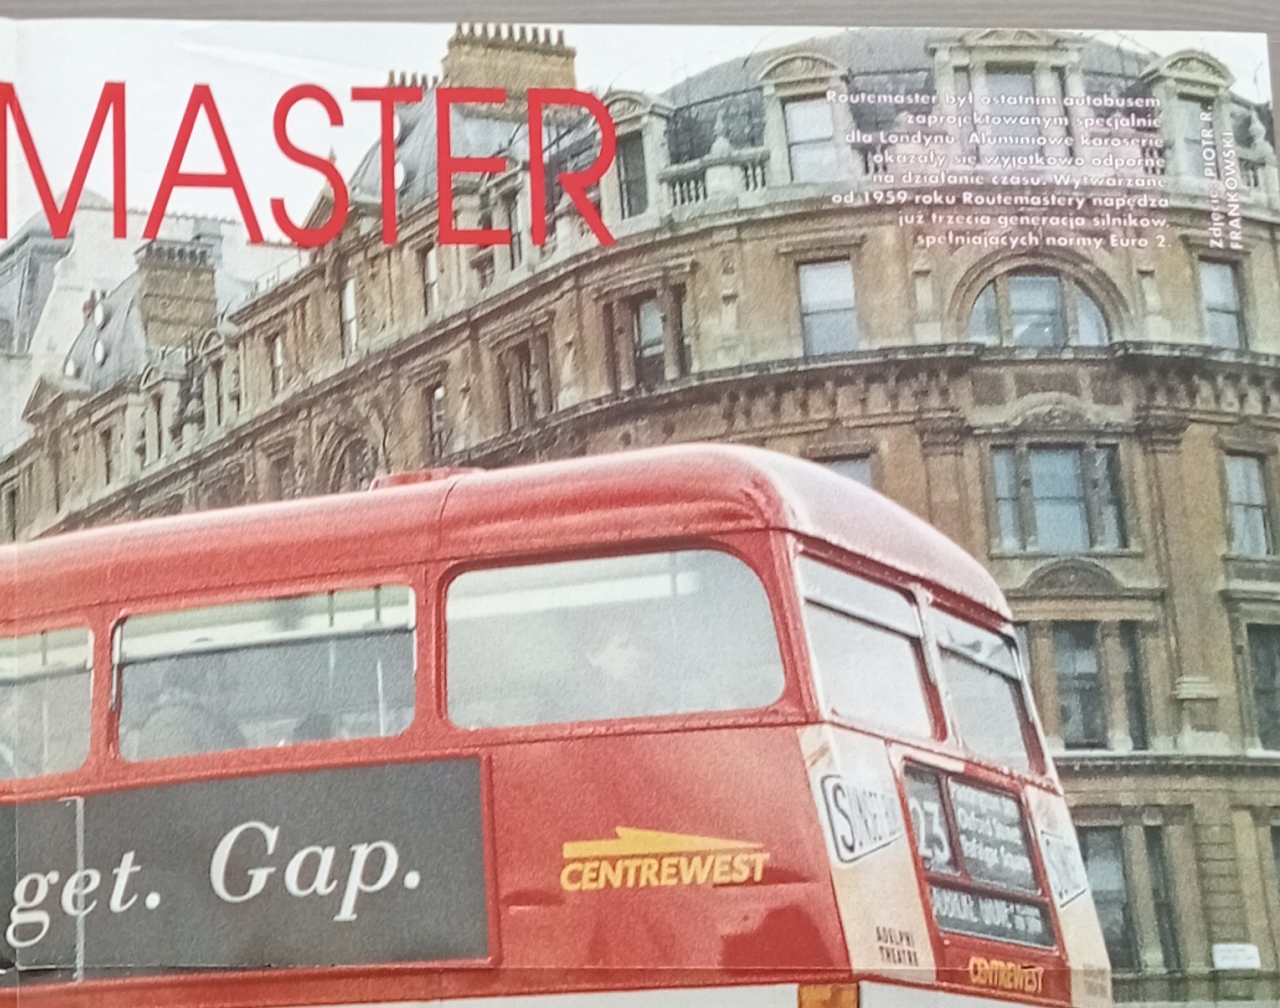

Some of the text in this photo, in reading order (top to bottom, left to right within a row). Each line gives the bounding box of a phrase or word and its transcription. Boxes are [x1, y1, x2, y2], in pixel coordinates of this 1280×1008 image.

[826, 90, 938, 105] Routemaster
[981, 93, 1057, 106] ostatnim
[1063, 94, 1161, 107] autobusem
[907, 112, 1162, 129] zaprojektowanym specjalnie
[1200, 105, 1212, 121] R.
[845, 130, 872, 144] dla
[969, 132, 1074, 145] Aluminiowe
[1081, 134, 1164, 147] karoserie
[1092, 153, 1166, 169] odporne
[1201, 129, 1216, 177] PIOTR
[873, 173, 894, 184] na
[992, 174, 1046, 186] czasu.
[1053, 174, 1167, 189] Wytwarzane
[1222, 131, 1244, 250] FRANKOWSKI
[832, 190, 1169, 210] od 1959 roku Routemastery napędza
[931, 212, 991, 225] trzecia
[997, 214, 1086, 229] generacja
[1045, 236, 1104, 249] normy
[1110, 234, 1149, 248] Euro
[1156, 234, 1172, 248] 2.
[559, 851, 771, 892] CENTREWEST
[5, 850, 162, 948] get.
[208, 819, 423, 922] Gap.
